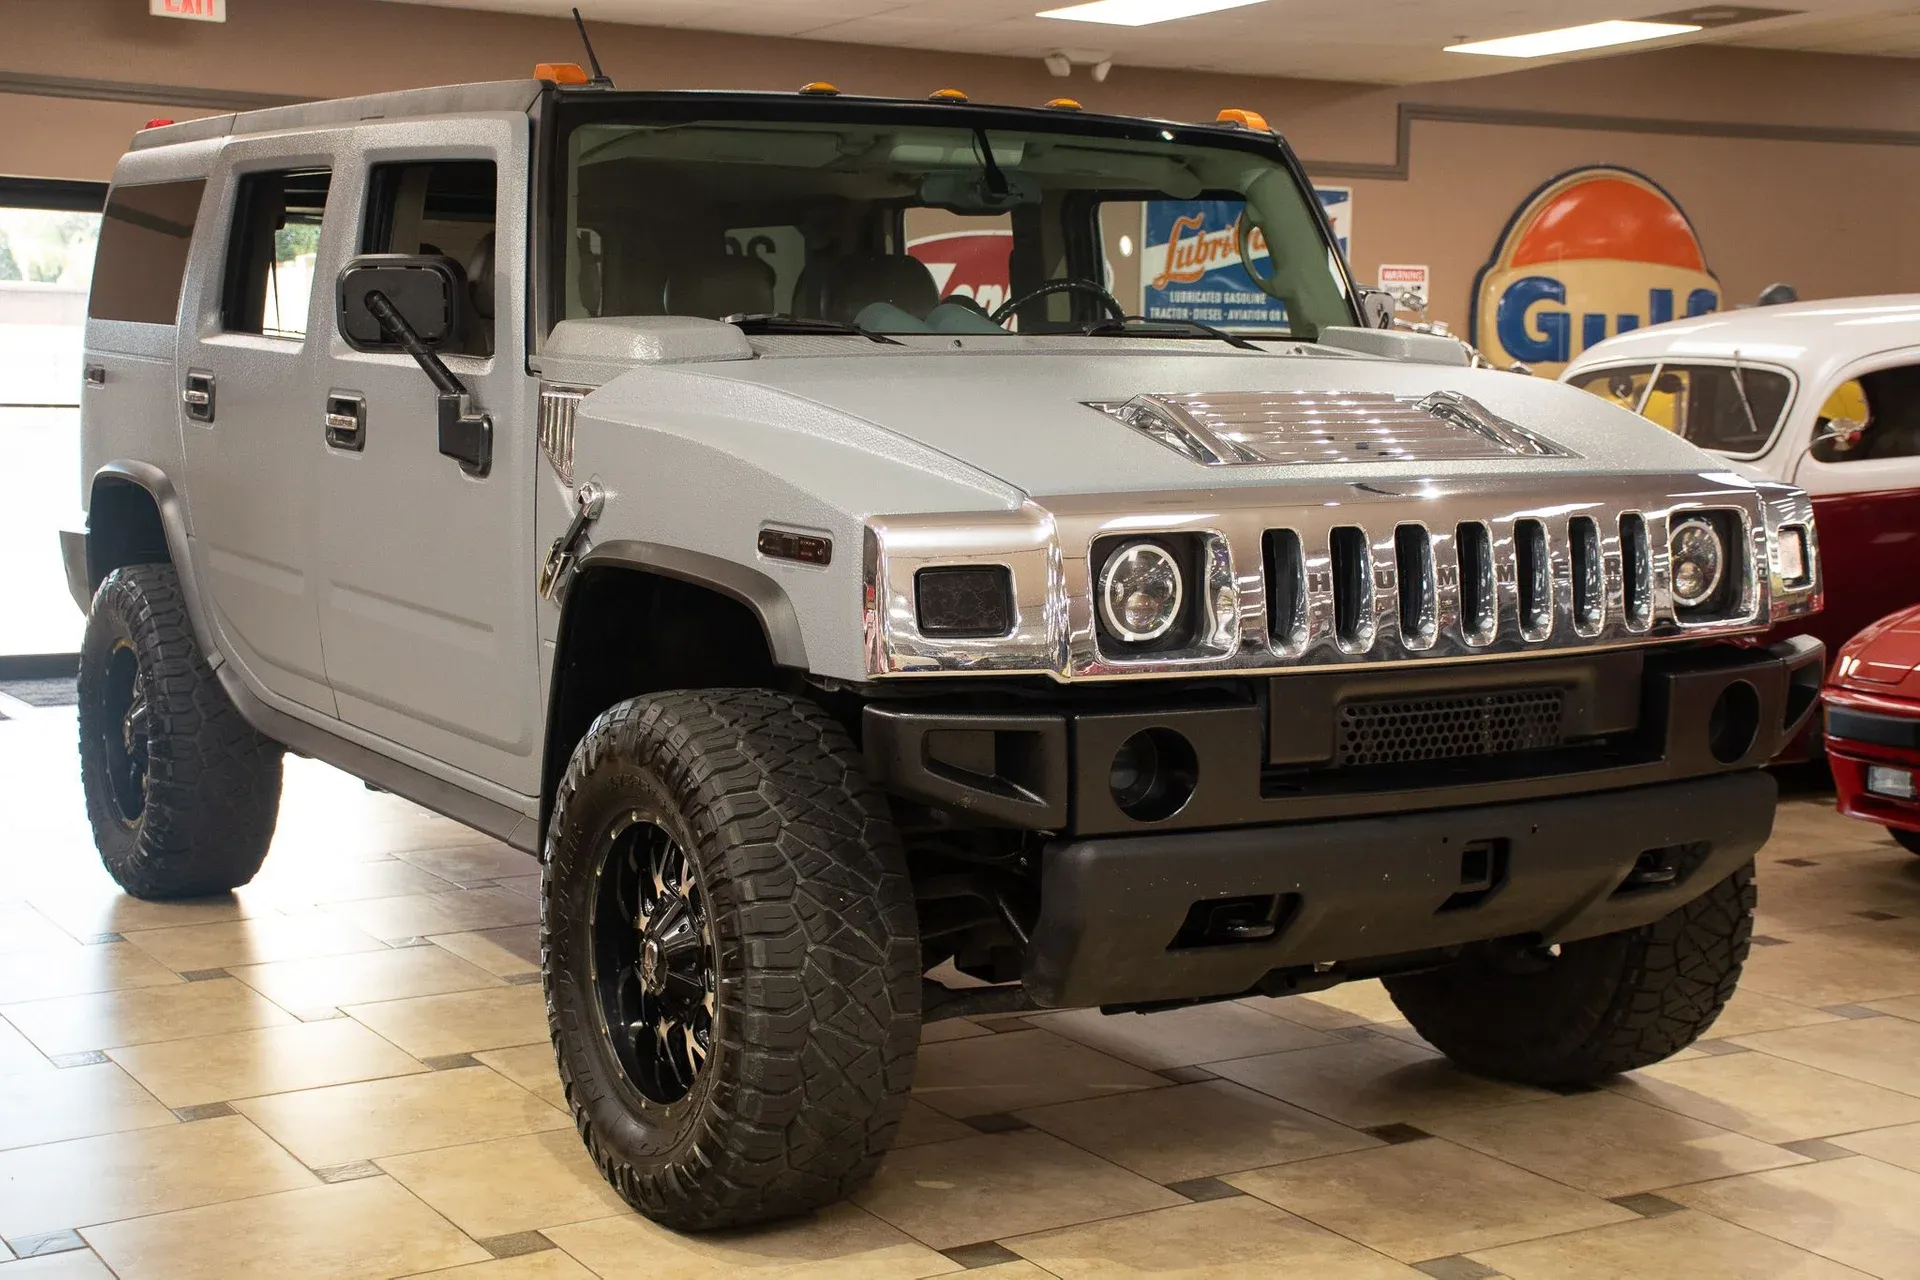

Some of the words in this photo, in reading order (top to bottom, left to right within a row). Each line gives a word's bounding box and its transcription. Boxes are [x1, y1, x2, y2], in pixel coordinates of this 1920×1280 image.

[1169, 291, 1222, 304] LUBRICATED
[1223, 292, 1267, 305] GASOLINE
[1150, 307, 1189, 320] TRACTOR
[1192, 308, 1223, 321] DIESEL
[1227, 309, 1268, 322] AVIATION
[1308, 557, 1620, 593] HUMMER
